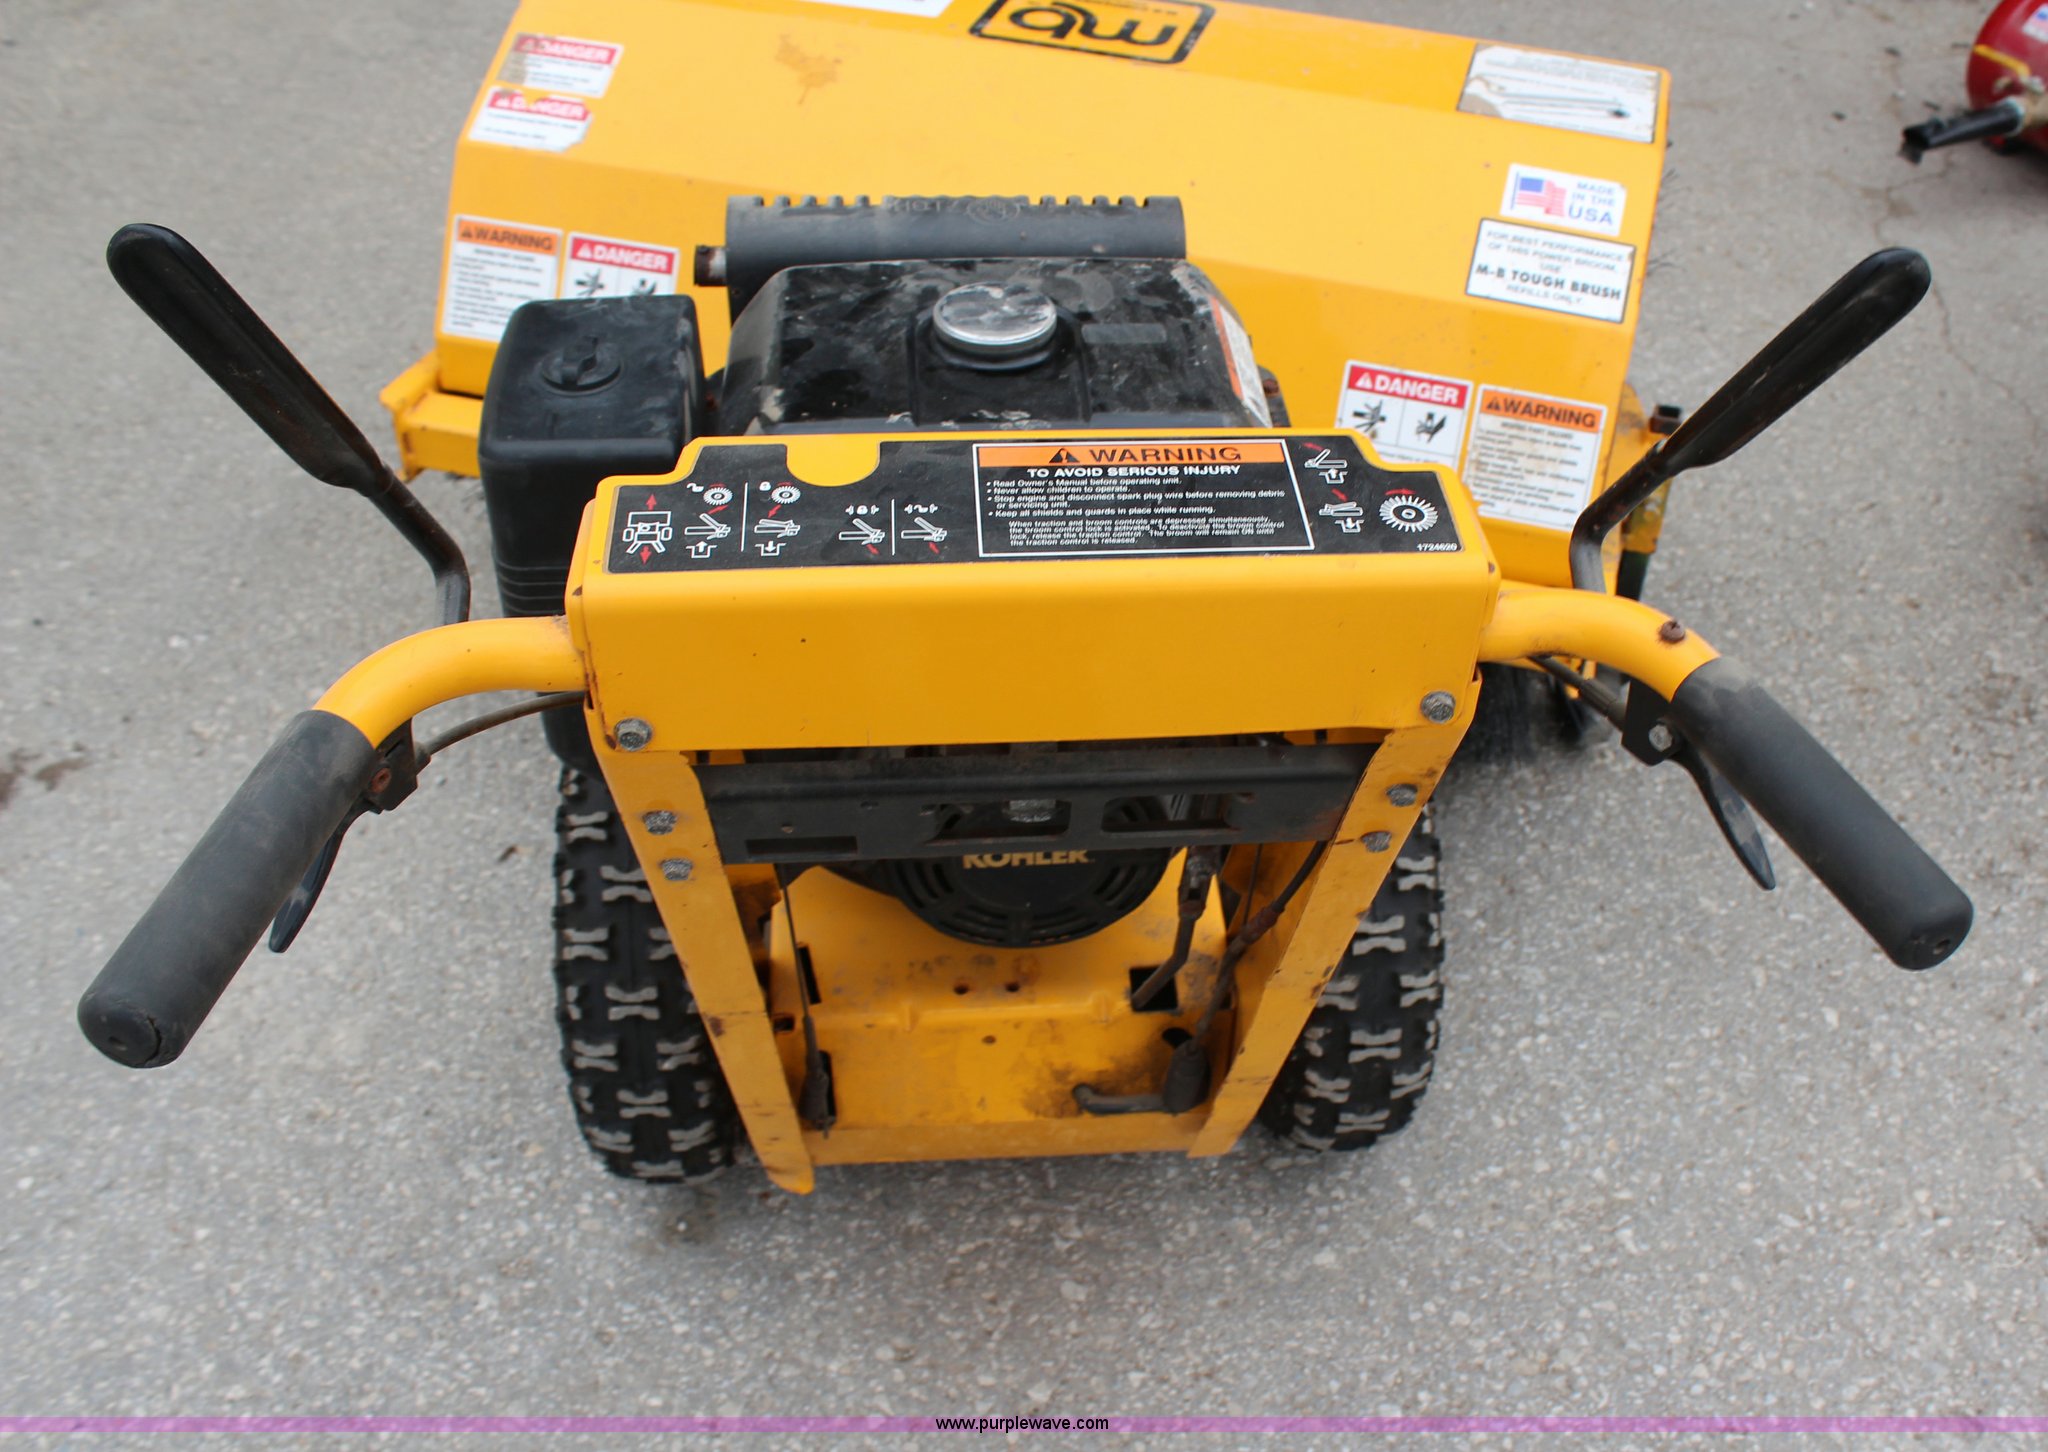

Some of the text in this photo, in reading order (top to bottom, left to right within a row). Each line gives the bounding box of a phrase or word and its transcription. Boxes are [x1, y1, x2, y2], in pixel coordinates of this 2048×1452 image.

[537, 39, 611, 61] DANGER
[512, 96, 585, 118] DNGER
[1577, 181, 1615, 195] MADE
[1572, 192, 1615, 207] IN THE
[1568, 204, 1613, 225] USA
[474, 227, 554, 250] WARNING
[1486, 230, 1624, 262] FOR BEST PERFORMANCE
[593, 245, 669, 271] DANGER
[1488, 242, 1502, 250] OF
[1507, 244, 1529, 256] THIS
[1532, 249, 1572, 263] POWER
[1540, 263, 1562, 273] USE
[1476, 264, 1622, 300] M-B TOUGH BRUSH
[1506, 284, 1549, 299] REFILLS
[1374, 374, 1460, 404] DANGER
[1503, 398, 1596, 428] WARNING
[1090, 447, 1241, 462] WARNING
[1027, 465, 1241, 478] TO AVOID SERIOUS INJURY
[1090, 478, 1117, 486] before
[1120, 477, 1161, 486] operating
[1163, 477, 1181, 485] unit.
[994, 487, 1019, 495] Never
[1047, 486, 1081, 494] children
[1095, 486, 1130, 494] operate.
[994, 495, 1015, 503] Stop
[1067, 493, 1115, 501] disconnect
[1117, 492, 1141, 501] spark
[1143, 492, 1163, 500] plug
[1164, 491, 1183, 499] wire
[1185, 490, 1213, 498] before
[1215, 490, 1256, 498] removing
[1258, 489, 1285, 497] debris
[995, 510, 1017, 518] Keep
[1020, 509, 1030, 517] all
[1066, 508, 1082, 516] and
[1085, 508, 1115, 516] guards
[1118, 507, 1126, 515] in
[1128, 507, 1151, 515] place
[1153, 506, 1177, 514] while
[1179, 506, 1216, 514] running.
[1009, 520, 1032, 528] When
[1114, 518, 1148, 526] controls
[1165, 517, 1206, 525] depressed
[1170, 522, 1210, 530] deactivate
[1227, 521, 1254, 529] broom
[1212, 528, 1239, 536] remain
[1257, 527, 1274, 535] until
[963, 850, 1089, 869] KOHLER
